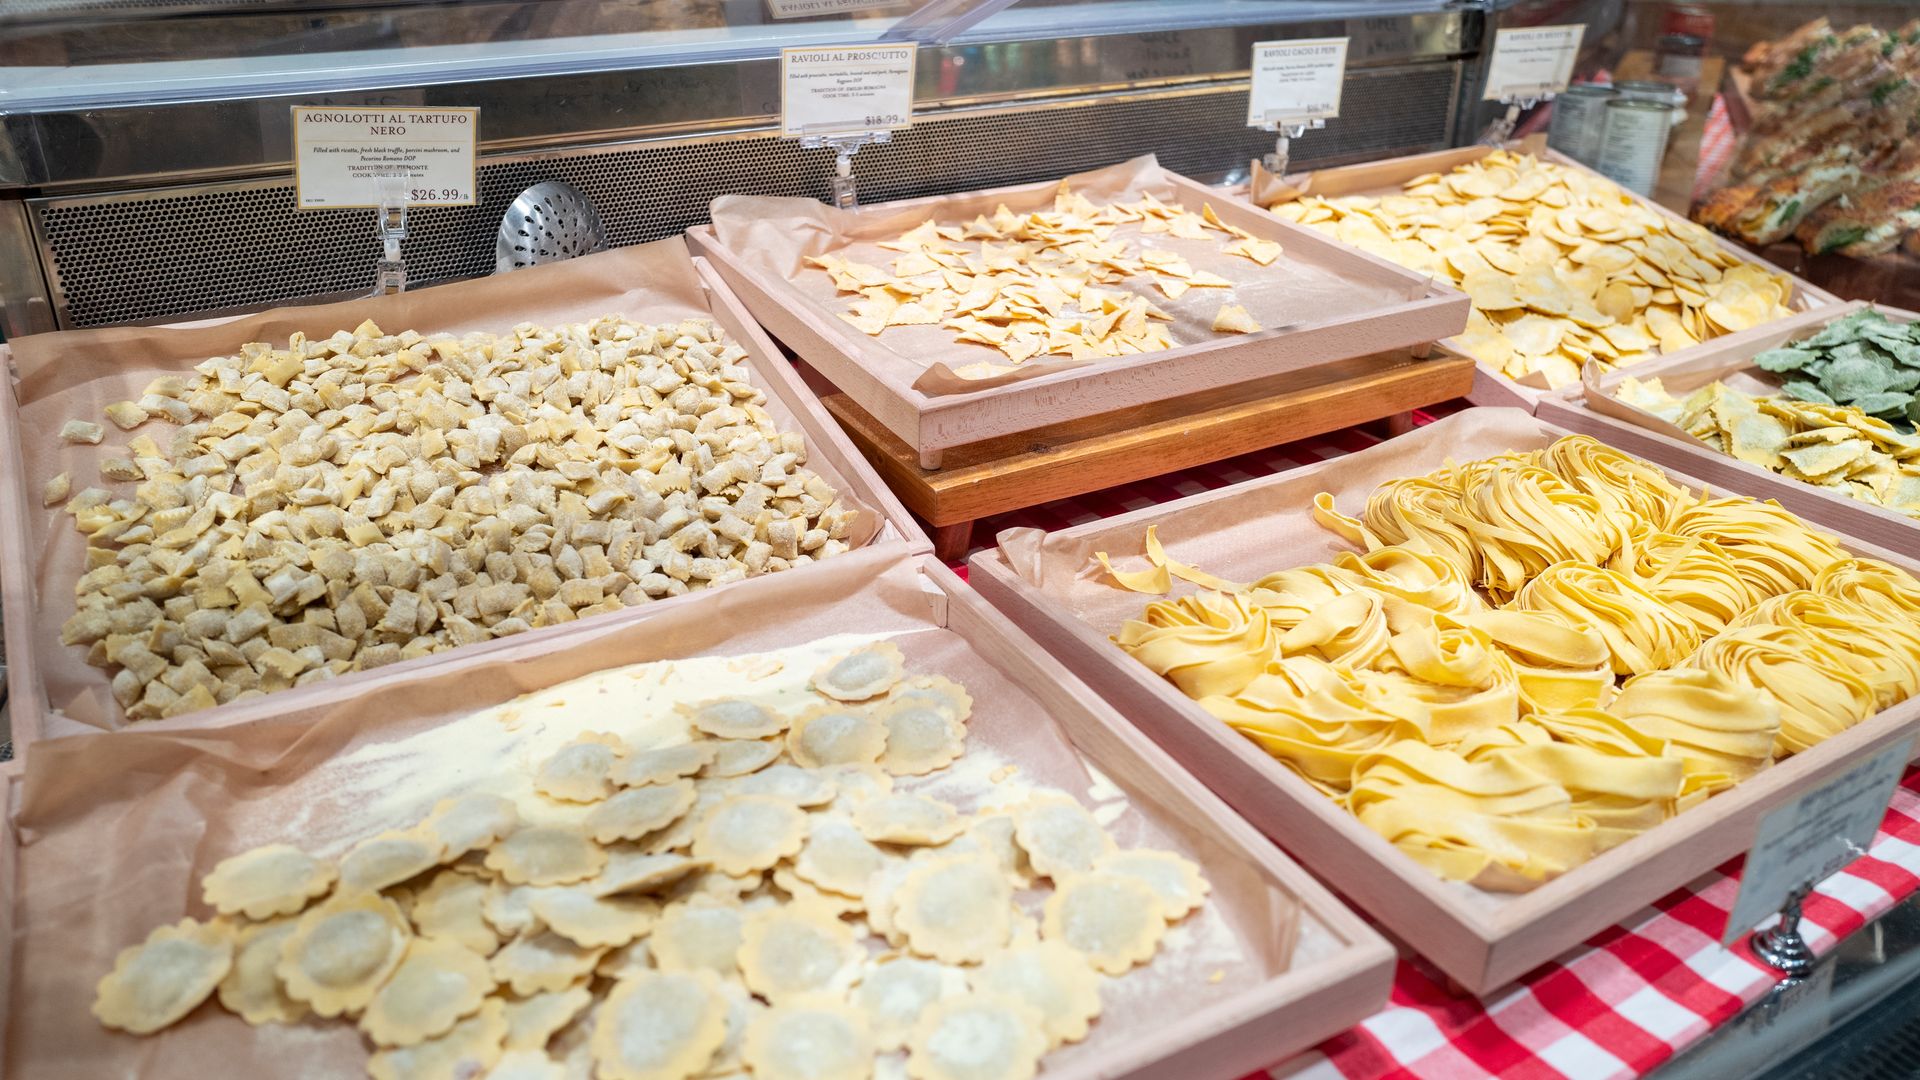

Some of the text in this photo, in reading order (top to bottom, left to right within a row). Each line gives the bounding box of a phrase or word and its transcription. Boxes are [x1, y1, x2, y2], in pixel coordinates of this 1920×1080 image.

[791, 53, 830, 63] RAVIOLI
[832, 53, 845, 61] AL
[303, 113, 468, 124] AGNOLOTTI AL TARTUFO
[370, 126, 406, 136] NERO
[360, 147, 373, 155] fresh
[387, 147, 405, 155] truffle,
